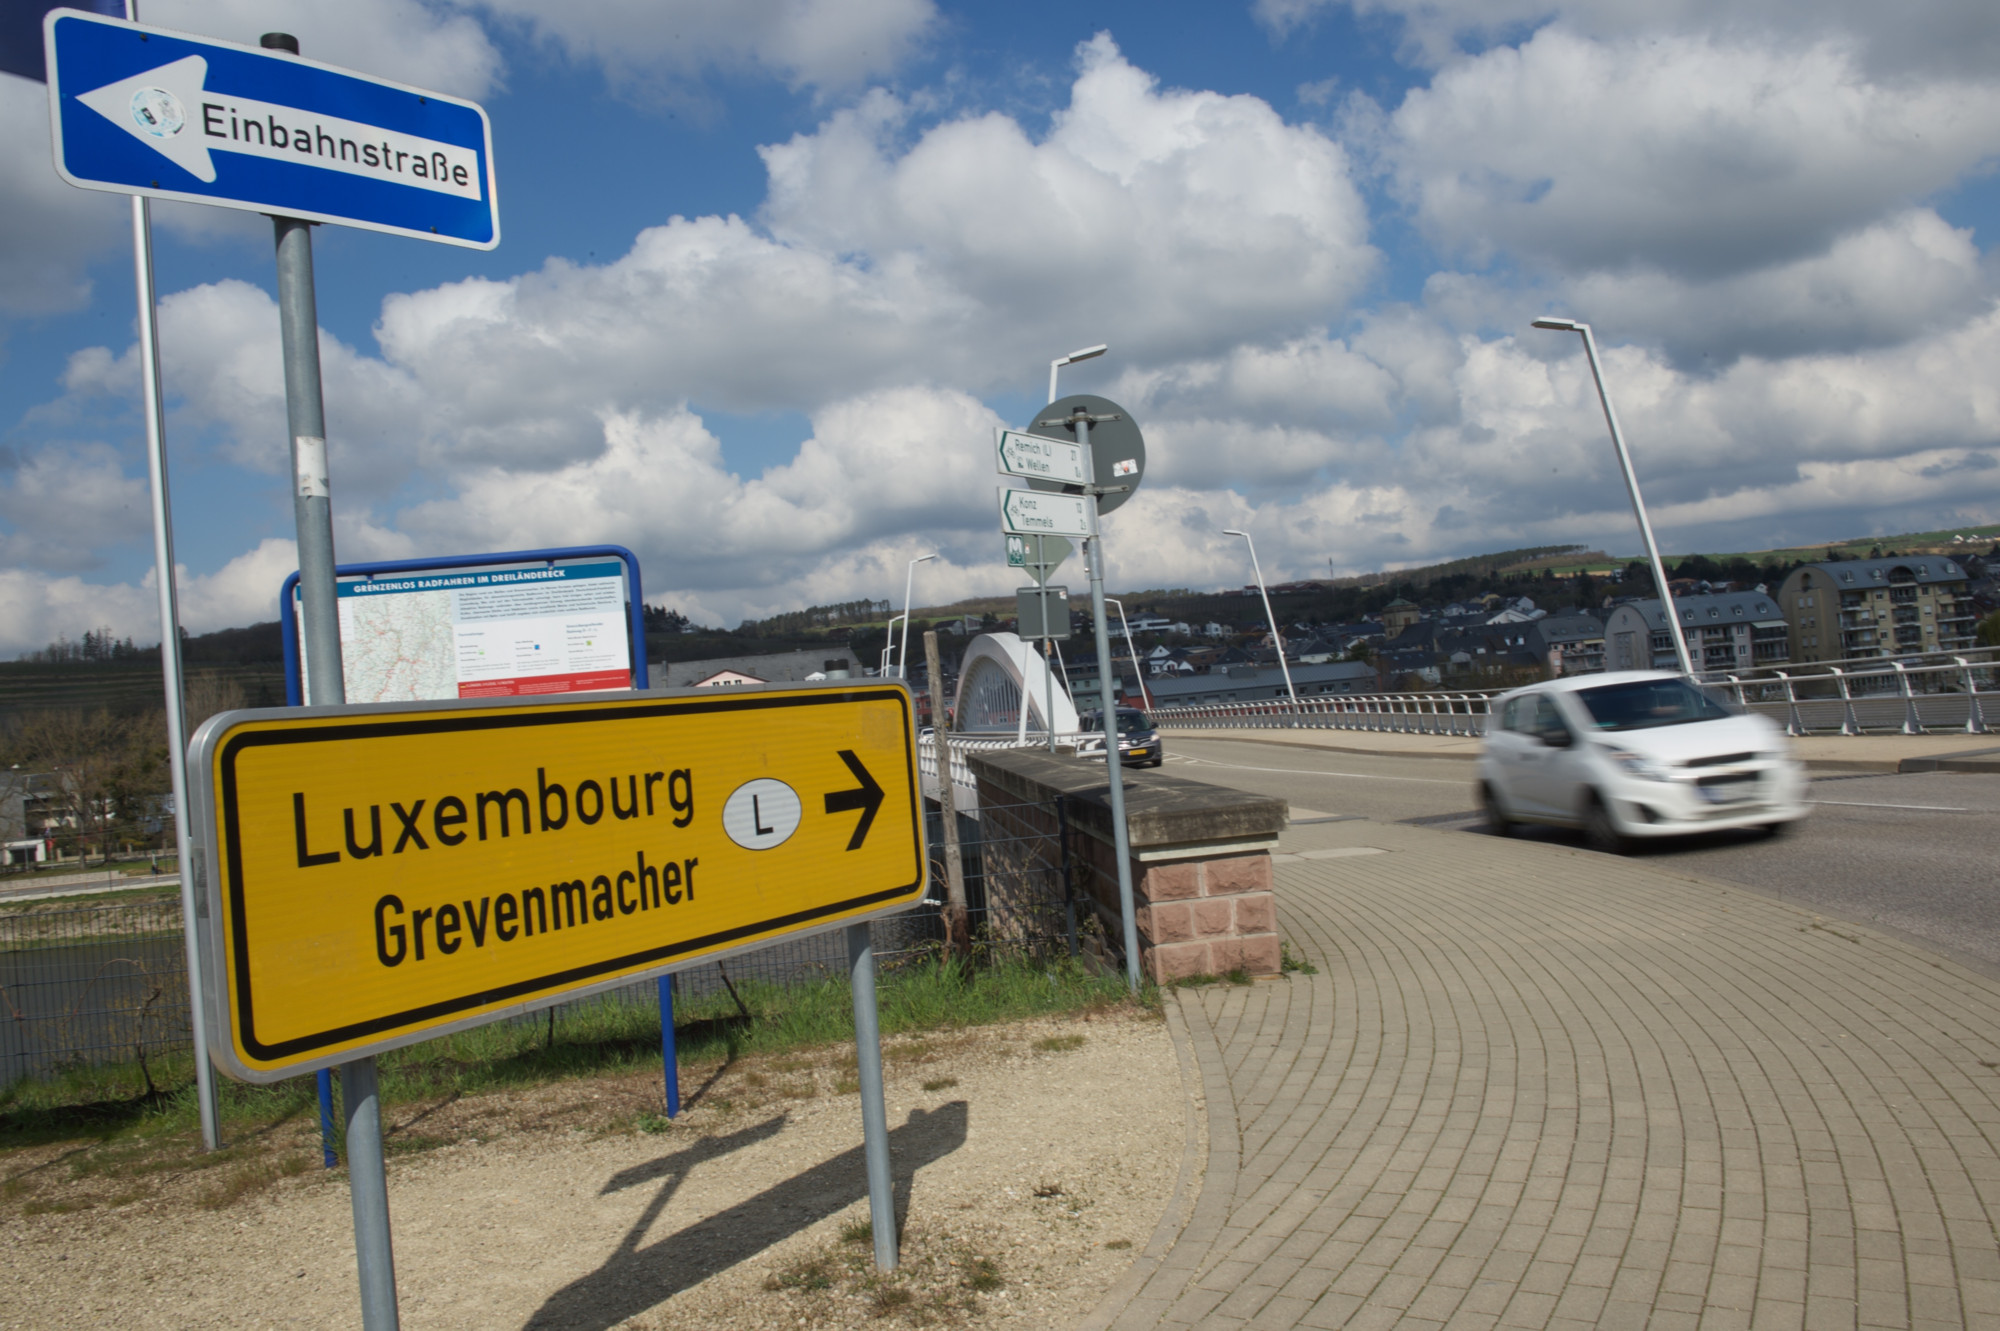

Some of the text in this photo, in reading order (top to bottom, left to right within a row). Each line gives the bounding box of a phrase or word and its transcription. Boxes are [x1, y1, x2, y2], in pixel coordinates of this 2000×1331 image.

[202, 102, 469, 188] Einbahnstraße
[1015, 439, 1041, 455] Remich
[1026, 458, 1050, 473] Wellen
[1019, 497, 1037, 510] Konz
[1021, 514, 1054, 528] Temmels
[353, 569, 566, 593] GRENZENLOS RADFAHREN IM DREILÄNDERECK
[293, 767, 775, 869] Luxembourg L
[374, 850, 700, 967] Grevenmacher
